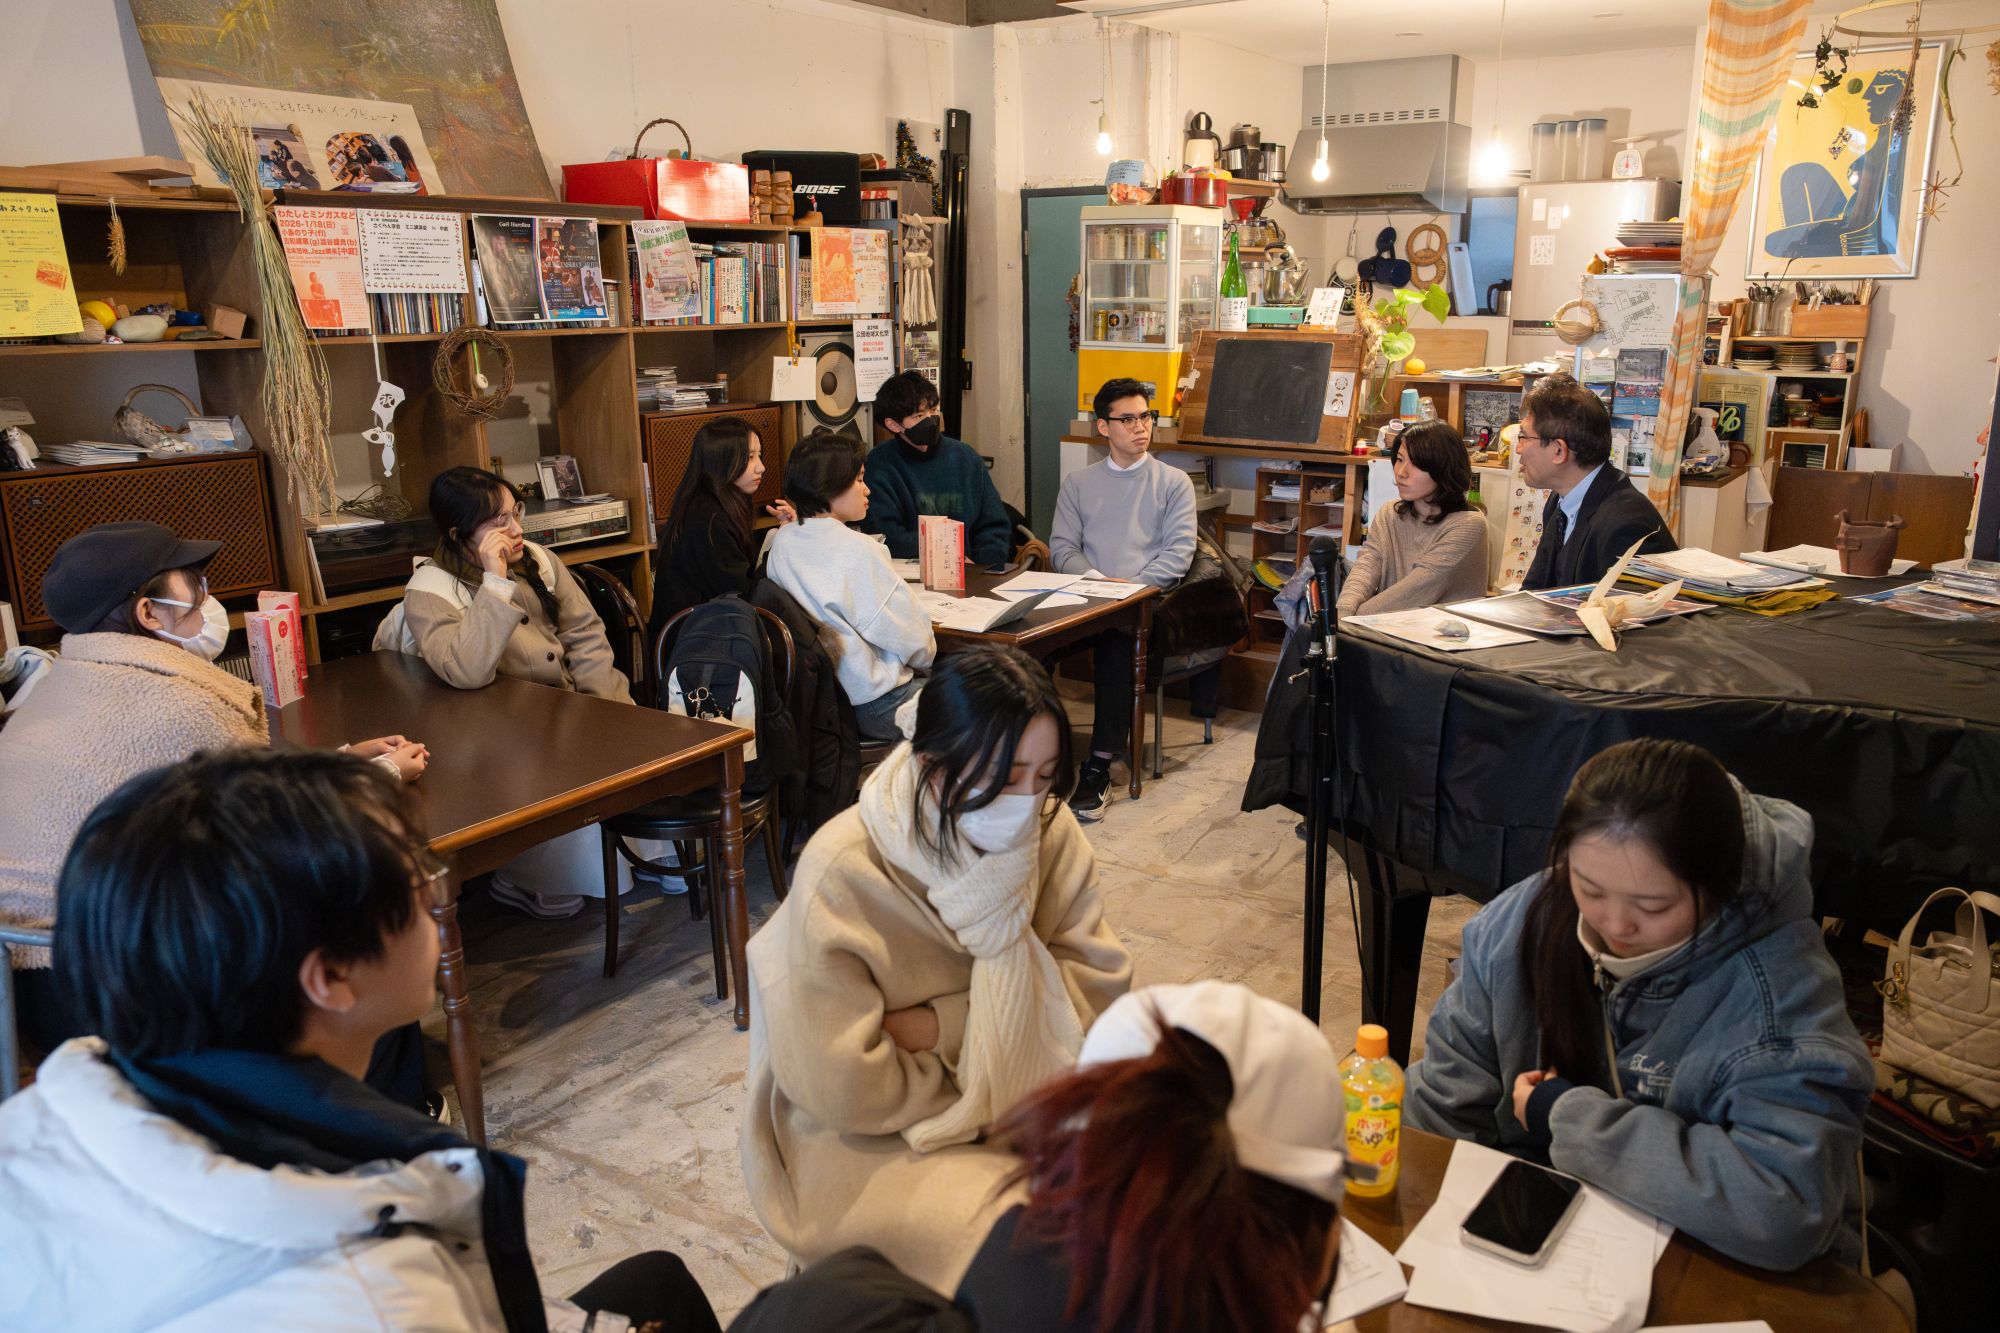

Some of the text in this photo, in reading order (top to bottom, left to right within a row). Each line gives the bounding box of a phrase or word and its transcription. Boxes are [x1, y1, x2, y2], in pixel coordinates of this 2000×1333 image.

[794, 184, 846, 194] BOSE
[277, 209, 356, 220] わたしとミンガスなど
[279, 219, 336, 229] 2026-1/18(日)
[1357, 1118, 1392, 1130] ホット
